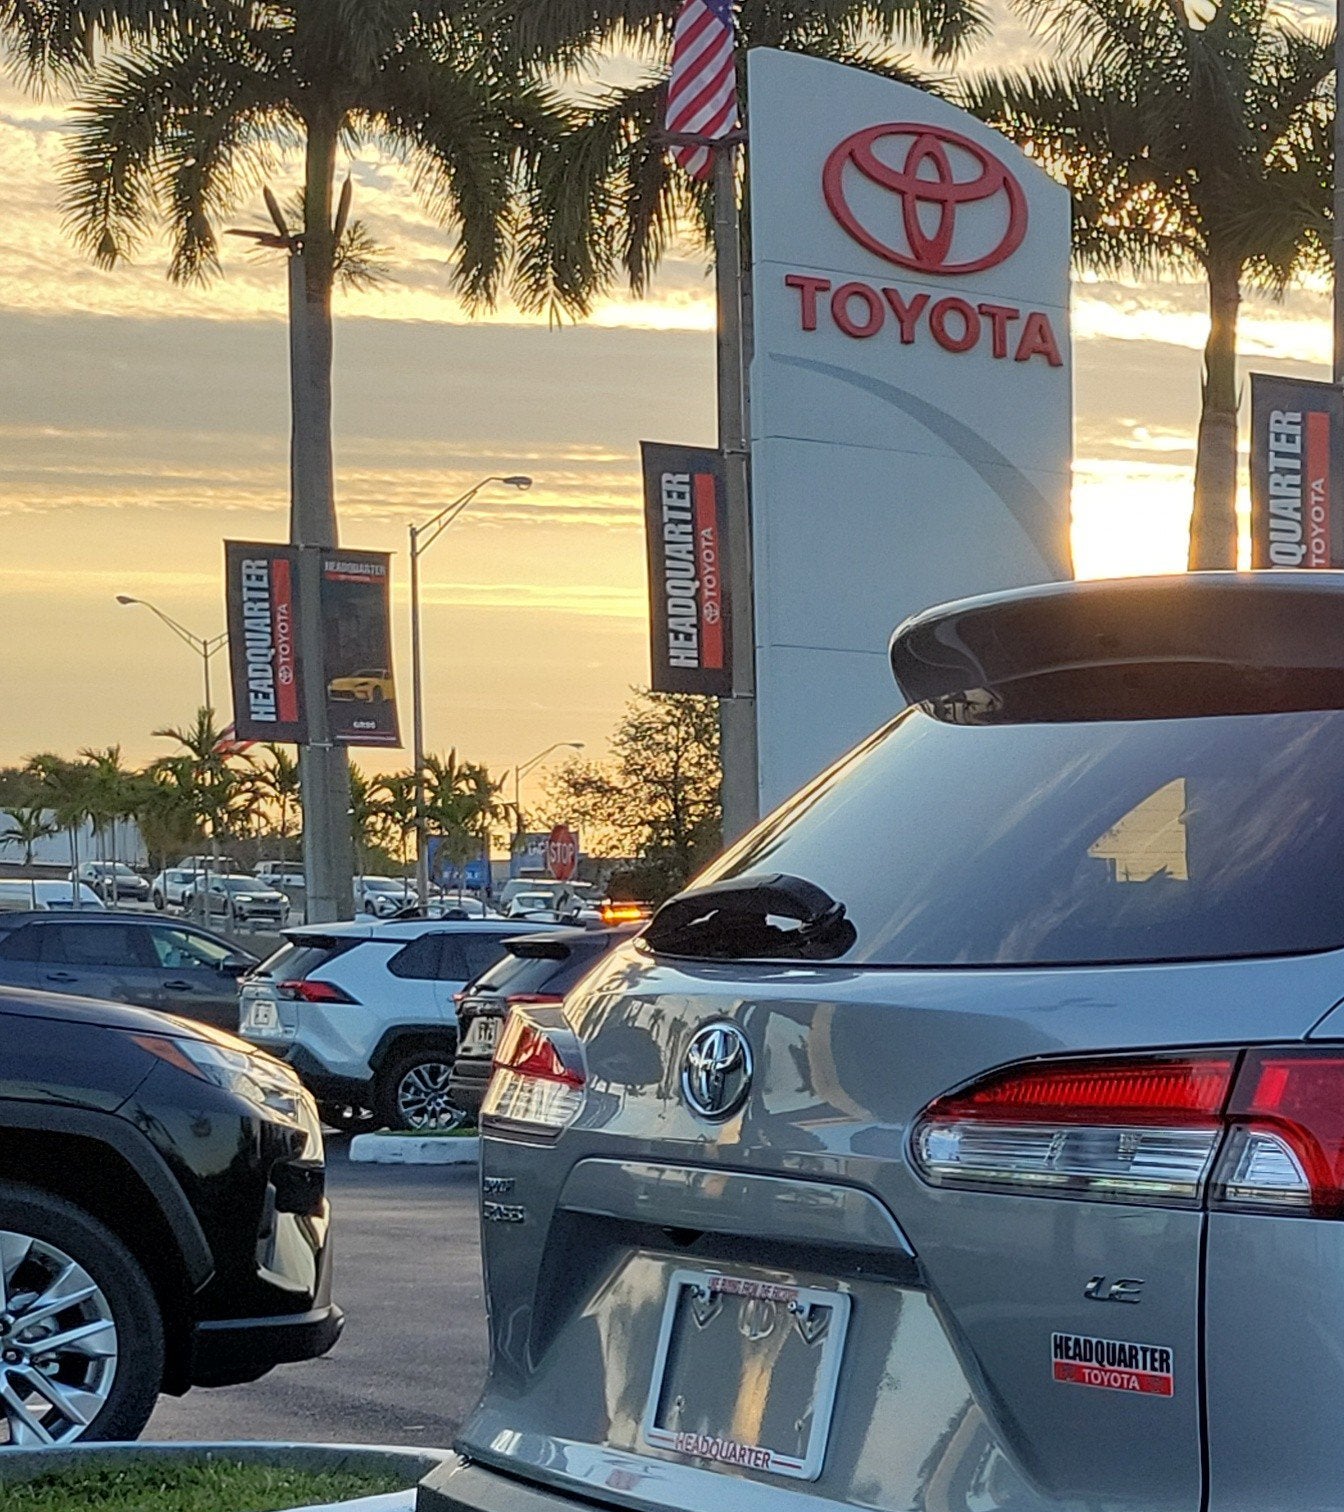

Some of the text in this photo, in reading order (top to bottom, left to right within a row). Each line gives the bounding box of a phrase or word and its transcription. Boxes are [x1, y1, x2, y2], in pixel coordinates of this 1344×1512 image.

[785, 274, 1063, 367] TOYOTA
[1269, 410, 1306, 569] QUARTER
[1311, 478, 1326, 566] TOYOTA
[662, 472, 700, 668] HEADQUARTER
[701, 527, 718, 598] TOYOTA
[242, 559, 277, 722] HEADQUARTER
[278, 603, 291, 663] TOYOTA
[550, 841, 574, 864] STOP
[1084, 1275, 1145, 1304] LE
[1053, 1334, 1171, 1373] HEADQUARTER
[1082, 1368, 1140, 1390] TOYOTA
[675, 1433, 771, 1469] HEADQUARTER
